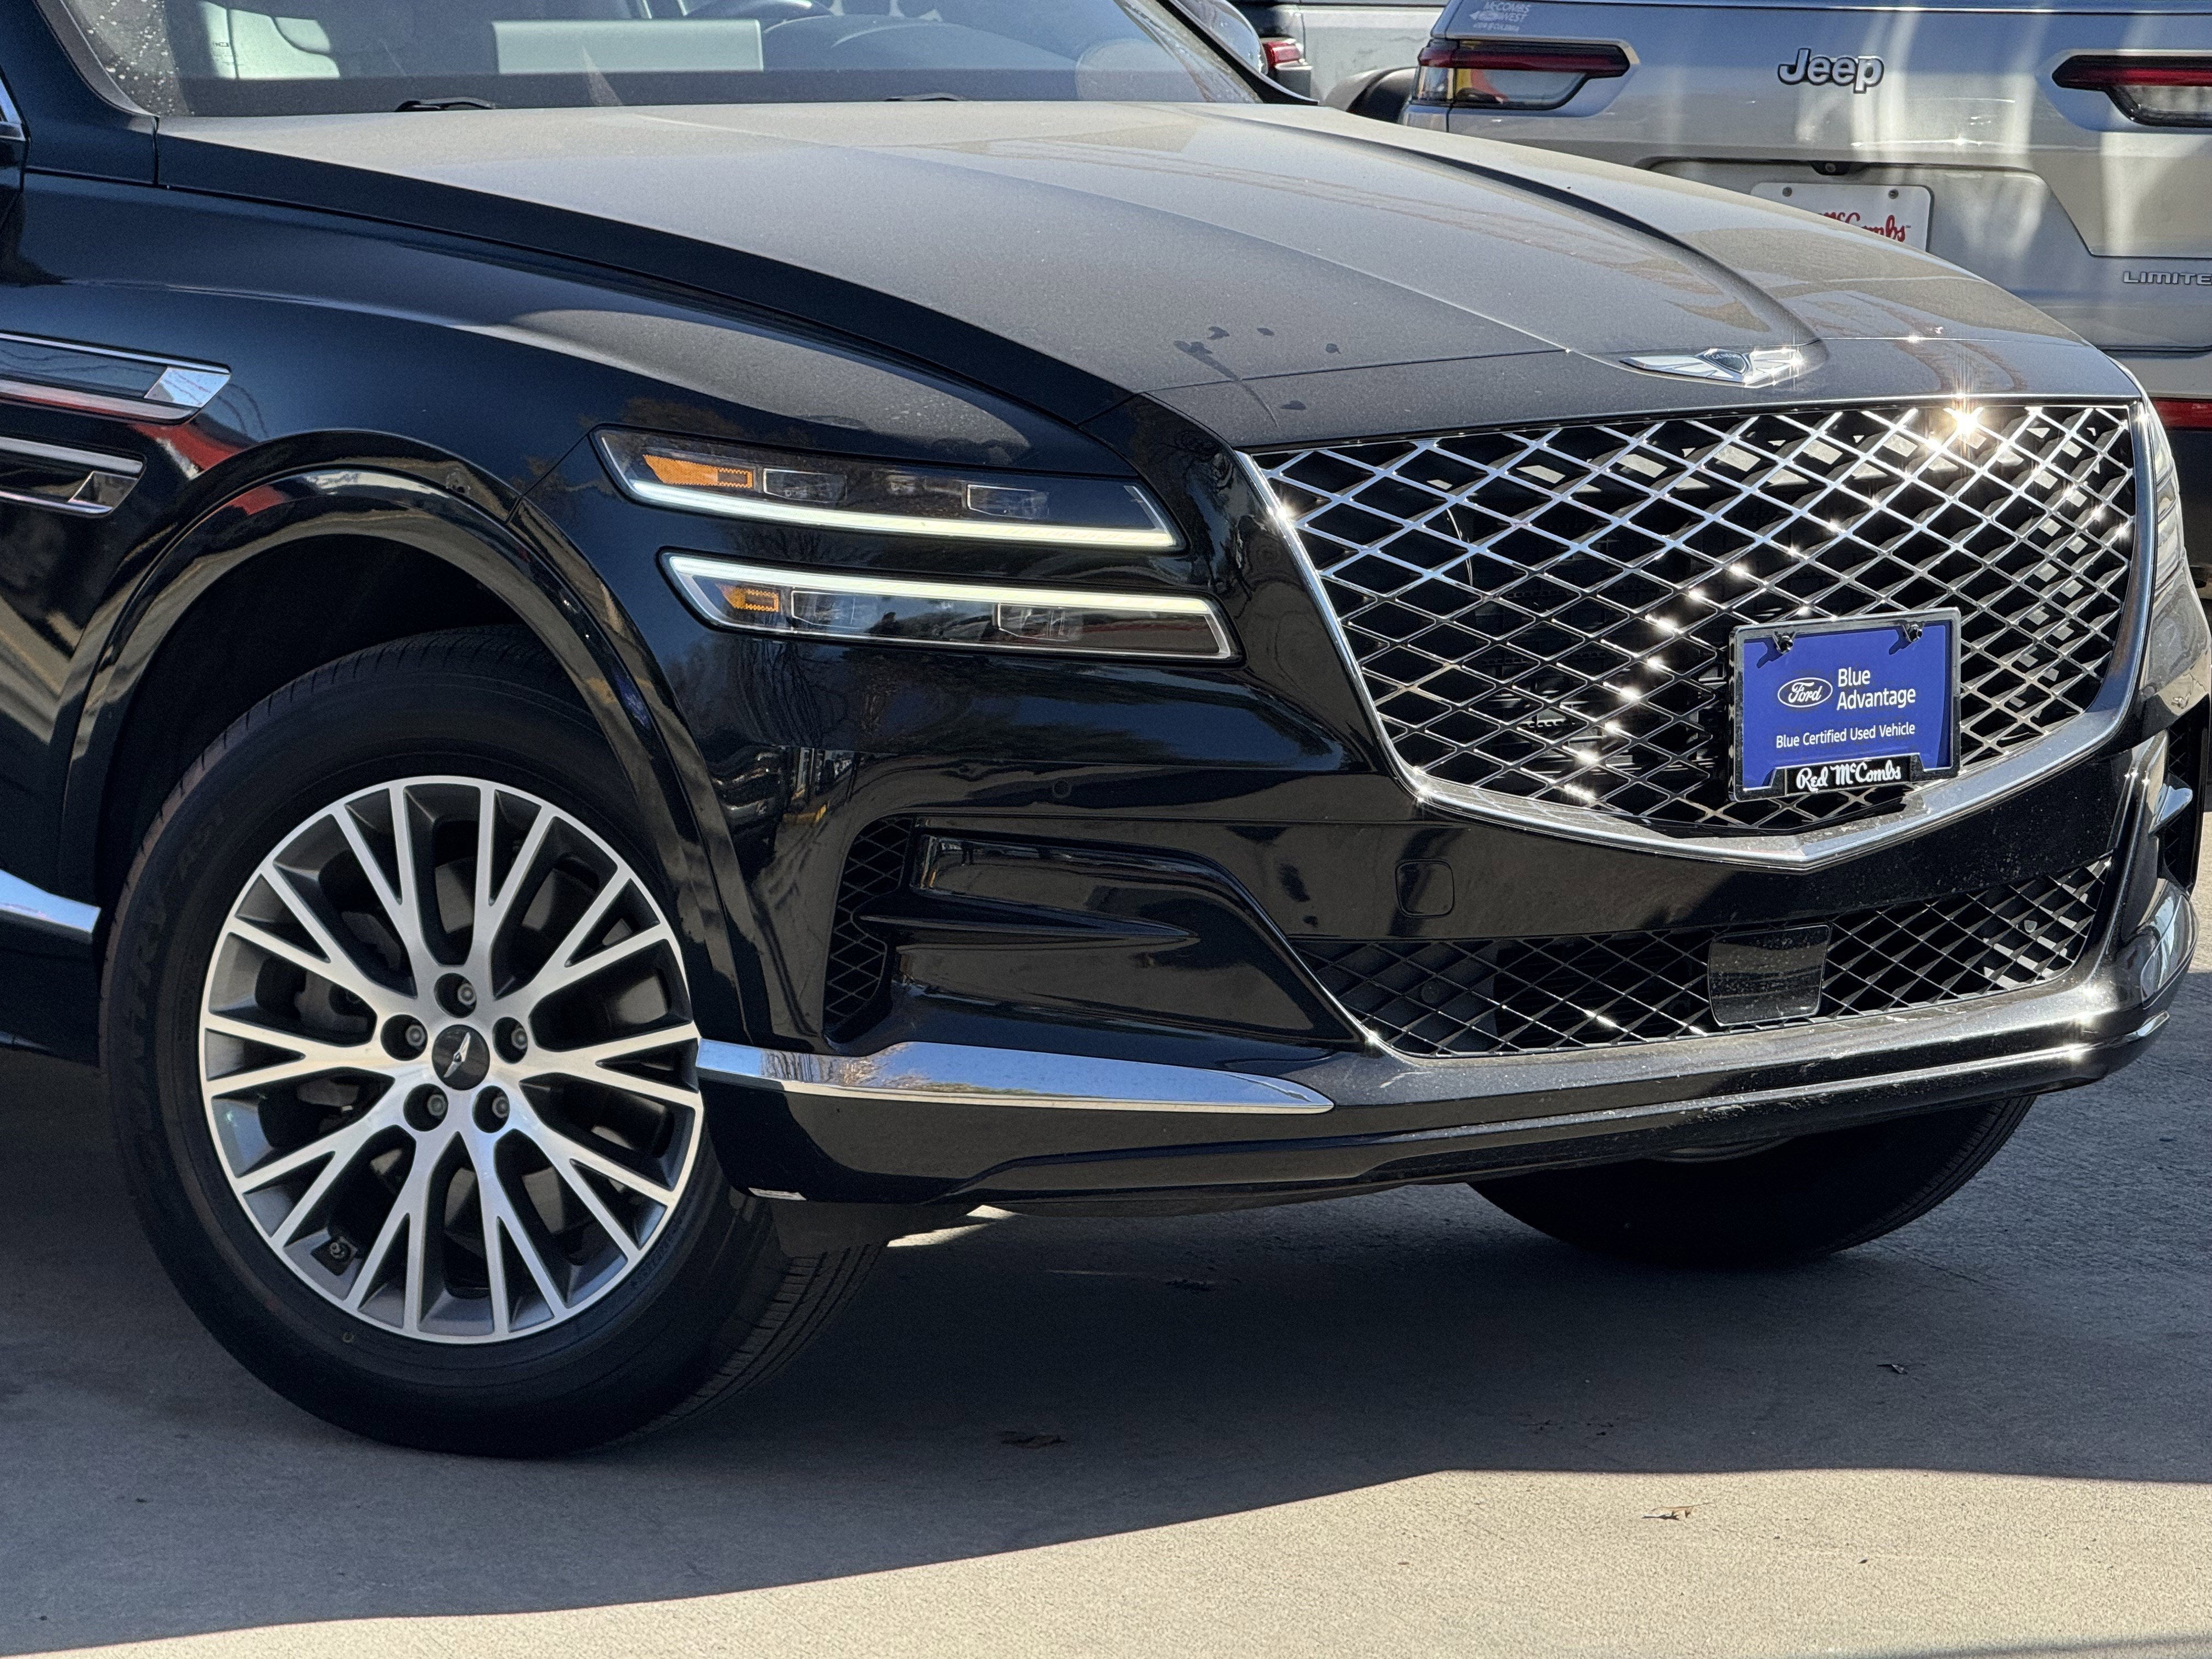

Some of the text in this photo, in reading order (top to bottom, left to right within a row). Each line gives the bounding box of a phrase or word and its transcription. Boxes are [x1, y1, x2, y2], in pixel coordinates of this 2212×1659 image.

[1778, 48, 1884, 94] Jeep
[1838, 667, 1871, 687] Blue
[1787, 682, 1822, 703] Ford
[1837, 688, 1916, 711] Advantage
[1776, 721, 1915, 748] Blue Certified Used Vehicle
[1797, 760, 1901, 792] Red McCombs
